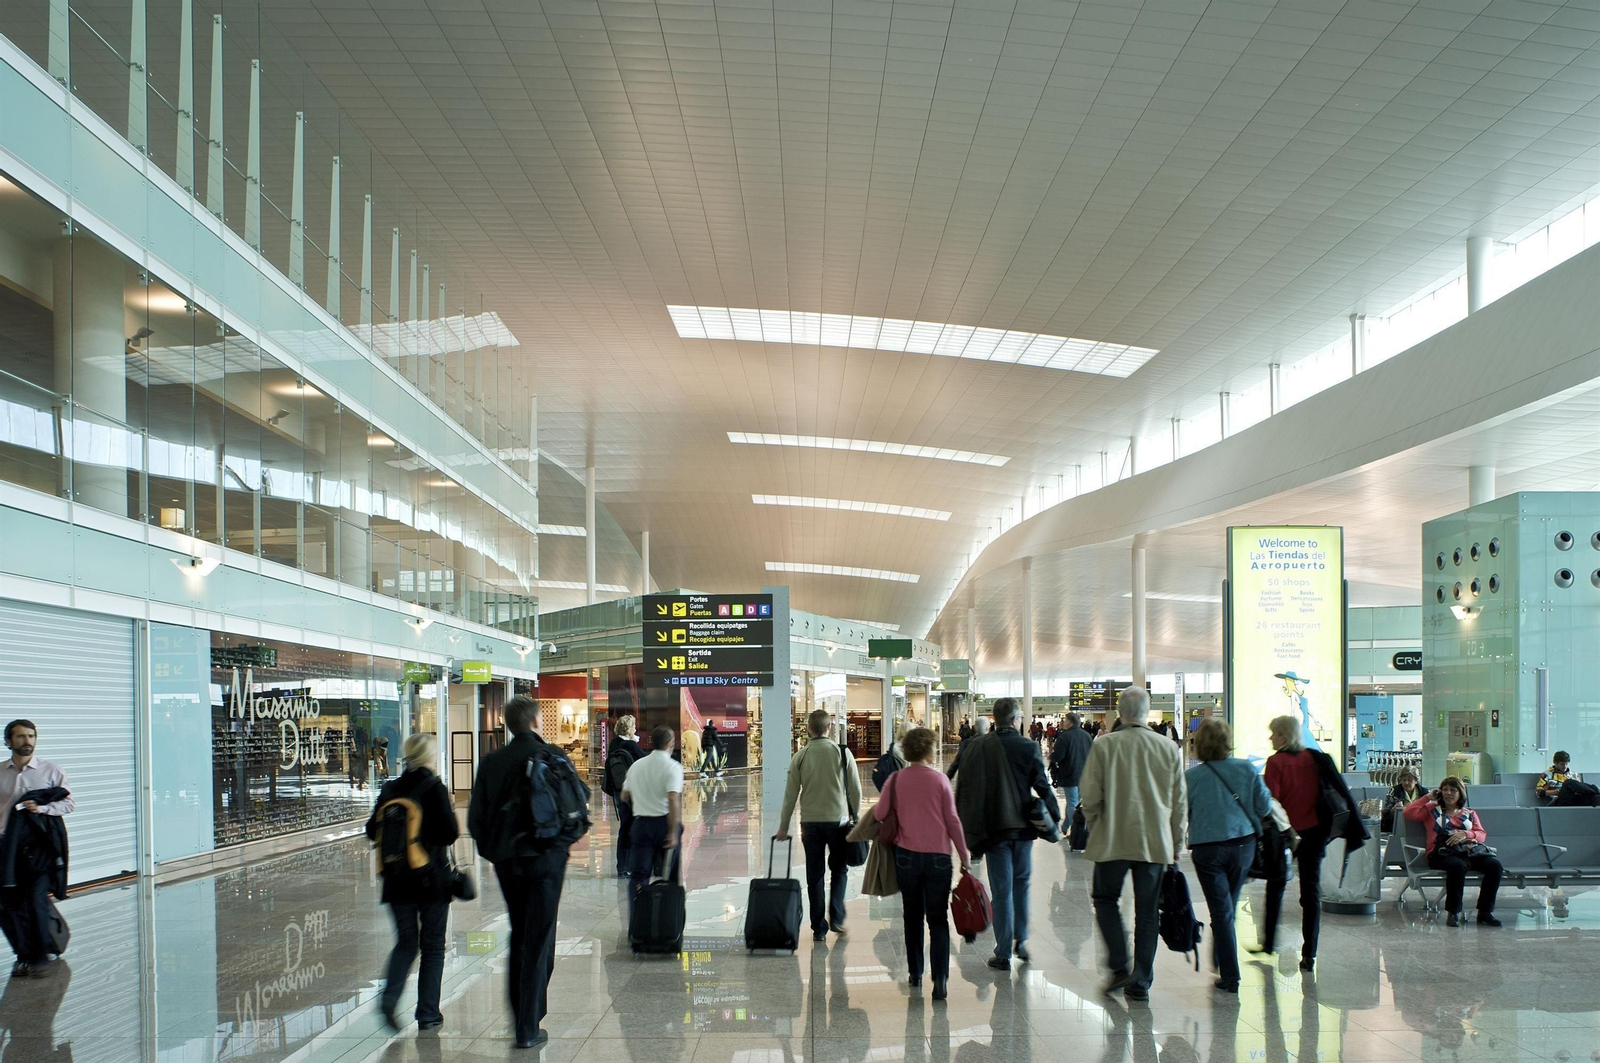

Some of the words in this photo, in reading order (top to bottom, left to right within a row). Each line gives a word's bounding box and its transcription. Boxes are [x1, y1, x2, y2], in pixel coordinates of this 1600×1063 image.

[1259, 538, 1305, 548] Welcome
[1308, 540, 1318, 548] to
[1250, 551, 1266, 560] Las
[1268, 551, 1309, 559] Tiendas
[1311, 551, 1326, 560] del
[1251, 562, 1325, 571] Aeropuerto
[1282, 578, 1310, 588] shops
[1256, 622, 1268, 630] 26
[1271, 622, 1321, 630] restaurant
[1274, 630, 1305, 639] points
[1396, 657, 1423, 665] CRY
[714, 677, 729, 686] Sky
[229, 668, 321, 726] Massimo
[278, 719, 329, 771] Dutti
